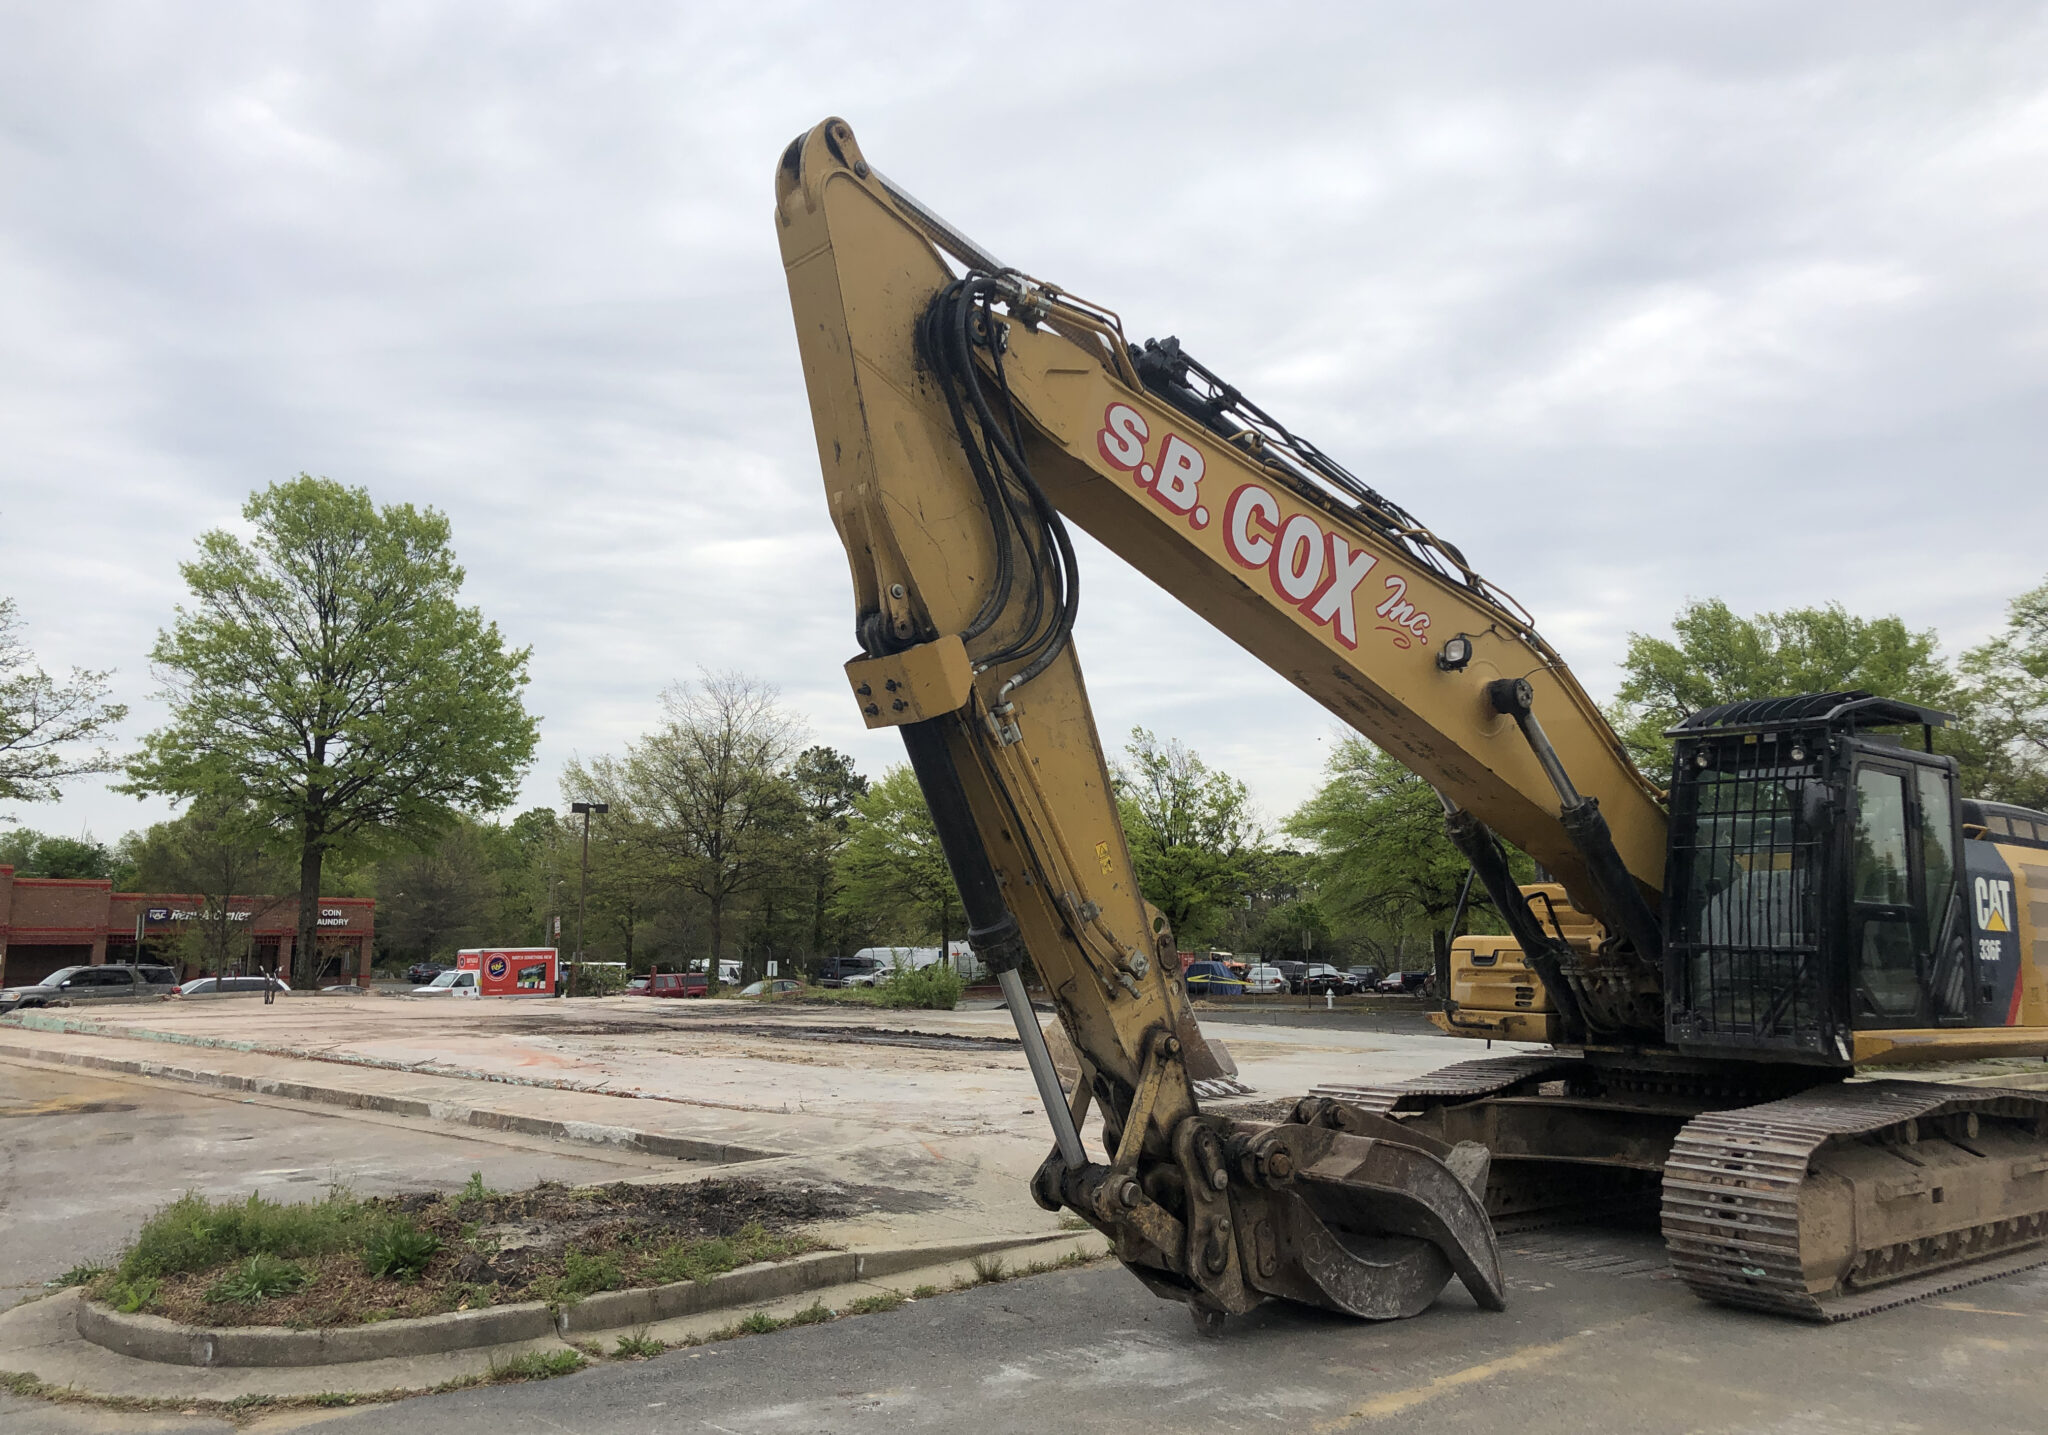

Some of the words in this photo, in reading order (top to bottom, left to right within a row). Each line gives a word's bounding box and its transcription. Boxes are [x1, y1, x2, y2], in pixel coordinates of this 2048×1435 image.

[1097, 401, 1210, 531] S.B.
[1222, 483, 1379, 650] COX
[1375, 574, 1431, 646] Inc.
[1975, 876, 2011, 932] CAT
[149, 909, 167, 920] RAC
[170, 909, 252, 920] Rent-A-Cnter
[322, 909, 342, 917] COIN
[316, 918, 349, 926] AUNDRY
[1979, 939, 2001, 960] 336F
